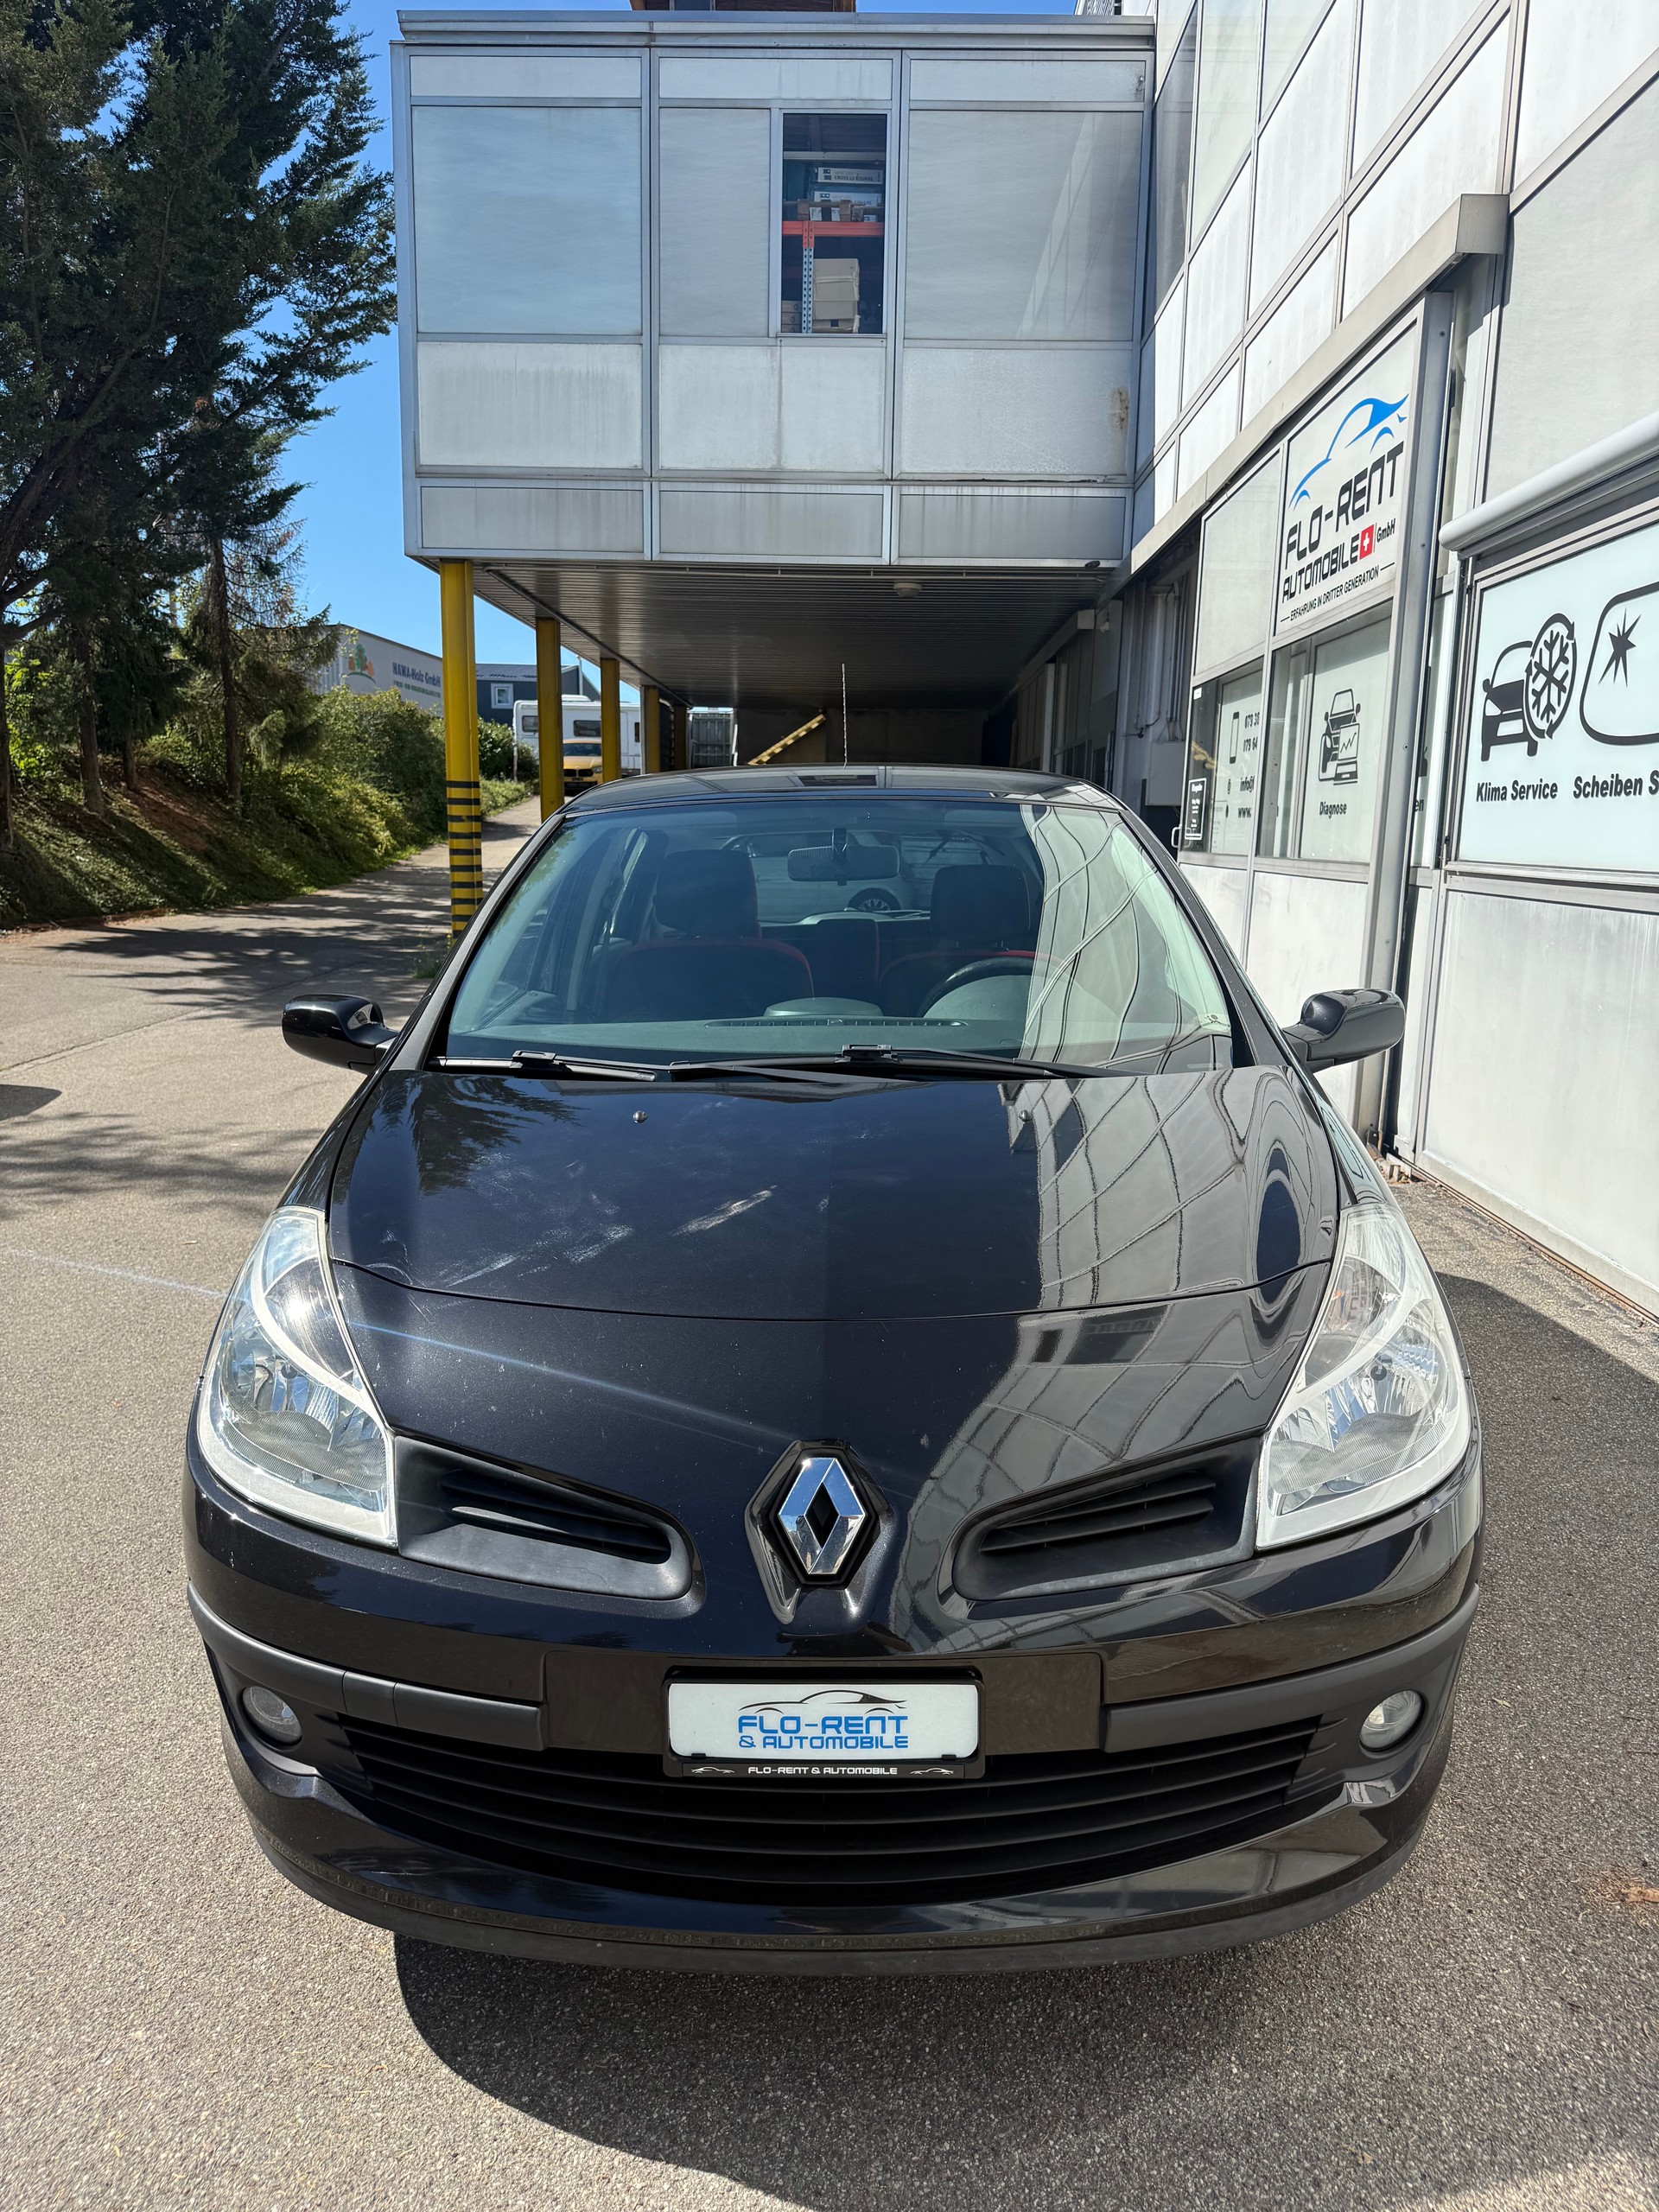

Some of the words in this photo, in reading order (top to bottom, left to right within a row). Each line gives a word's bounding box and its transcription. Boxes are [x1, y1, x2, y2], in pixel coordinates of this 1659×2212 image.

[1285, 441, 1404, 569] FLO-RENT
[1282, 533, 1359, 603] AUTOMOBILE
[1376, 518, 1395, 543] GmbH
[1290, 598, 1316, 621] ERFAHRUNG
[1317, 597, 1322, 608] IN
[1323, 584, 1344, 604] DRITTER
[1344, 564, 1379, 594] GENERATION
[1476, 782, 1507, 802] Klima
[1511, 779, 1558, 801] Service
[1573, 773, 1643, 799] Scheiben
[1319, 801, 1347, 819] Diagnose
[738, 1715, 908, 1734] FLO-RENT
[739, 1735, 756, 1748] &
[762, 1735, 908, 1750] AUTOMOBILE
